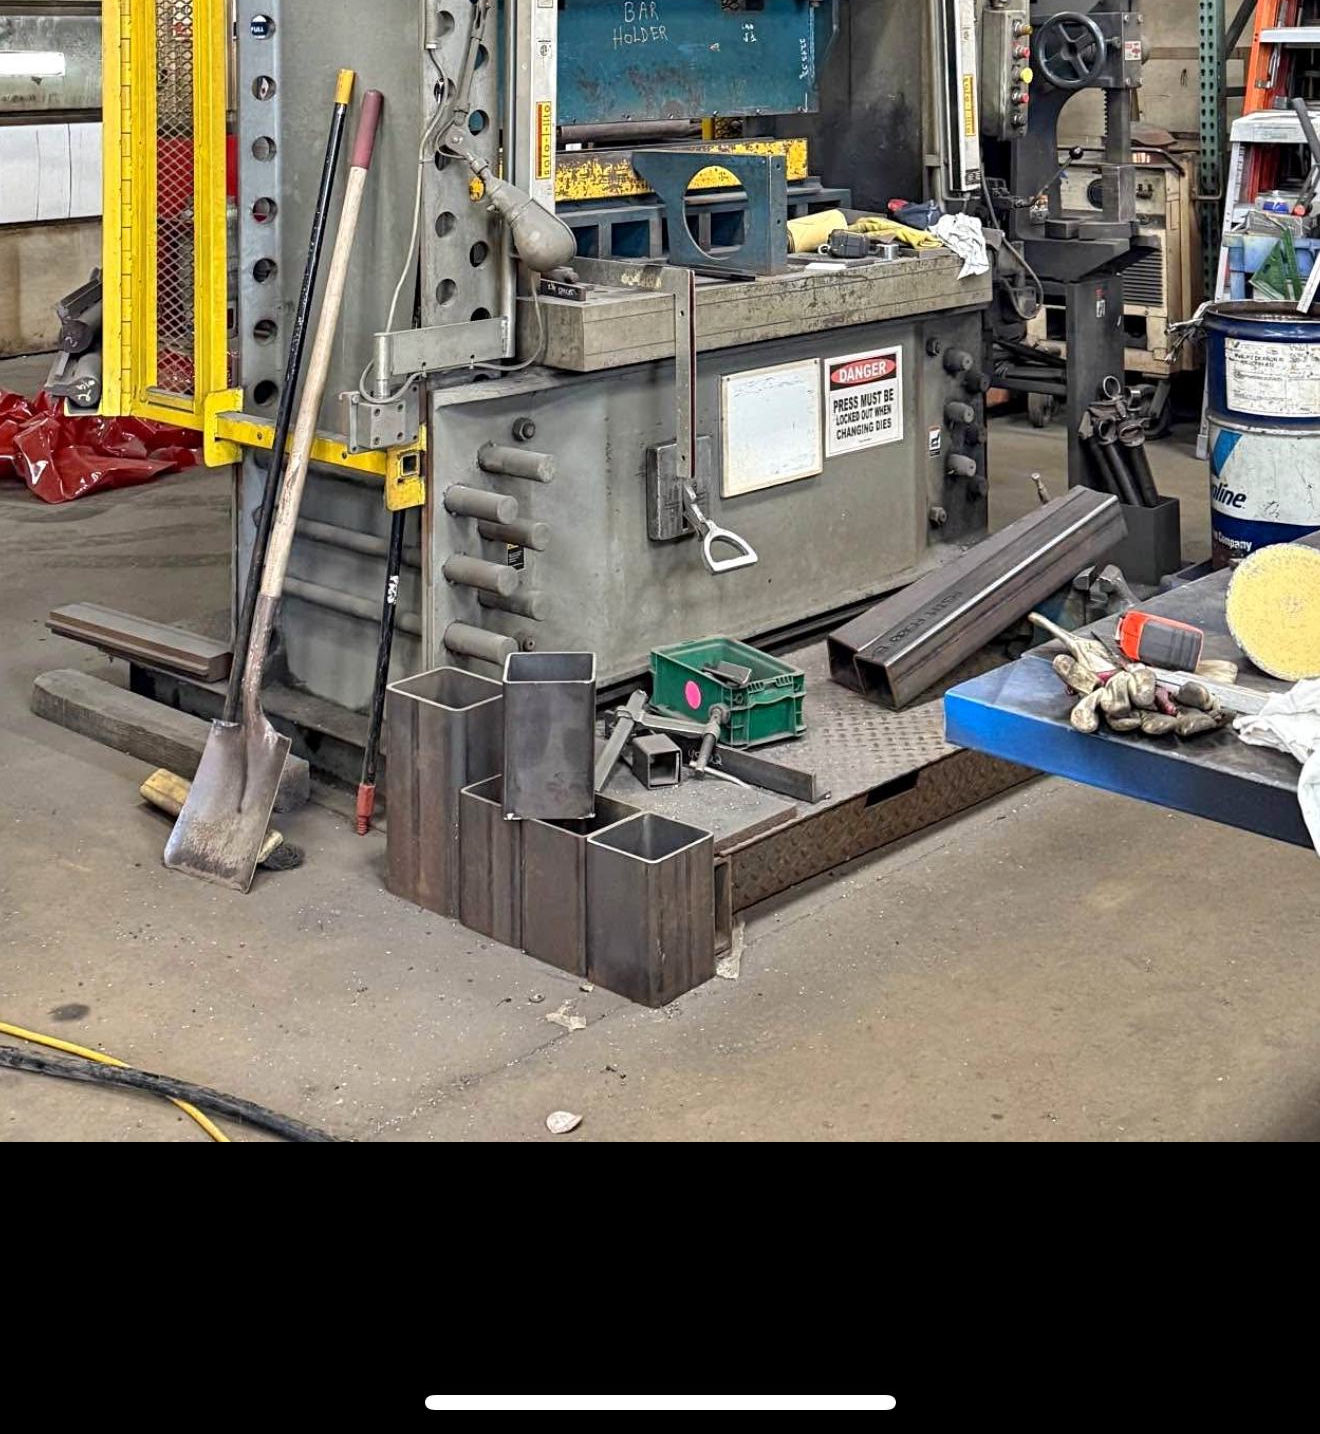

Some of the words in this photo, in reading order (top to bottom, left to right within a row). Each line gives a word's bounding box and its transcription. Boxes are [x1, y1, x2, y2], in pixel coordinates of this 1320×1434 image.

[624, 1, 660, 23] BAR
[612, 25, 669, 50] HOLDER
[839, 361, 887, 382] DANGER
[833, 395, 859, 414] PRESS
[860, 391, 882, 408] MUST
[884, 388, 894, 402] BE
[835, 410, 861, 426] LOCKED
[861, 407, 873, 421] OUT
[874, 404, 892, 417] WHEN
[836, 422, 874, 440] CHANGING
[876, 418, 892, 431] DIES
